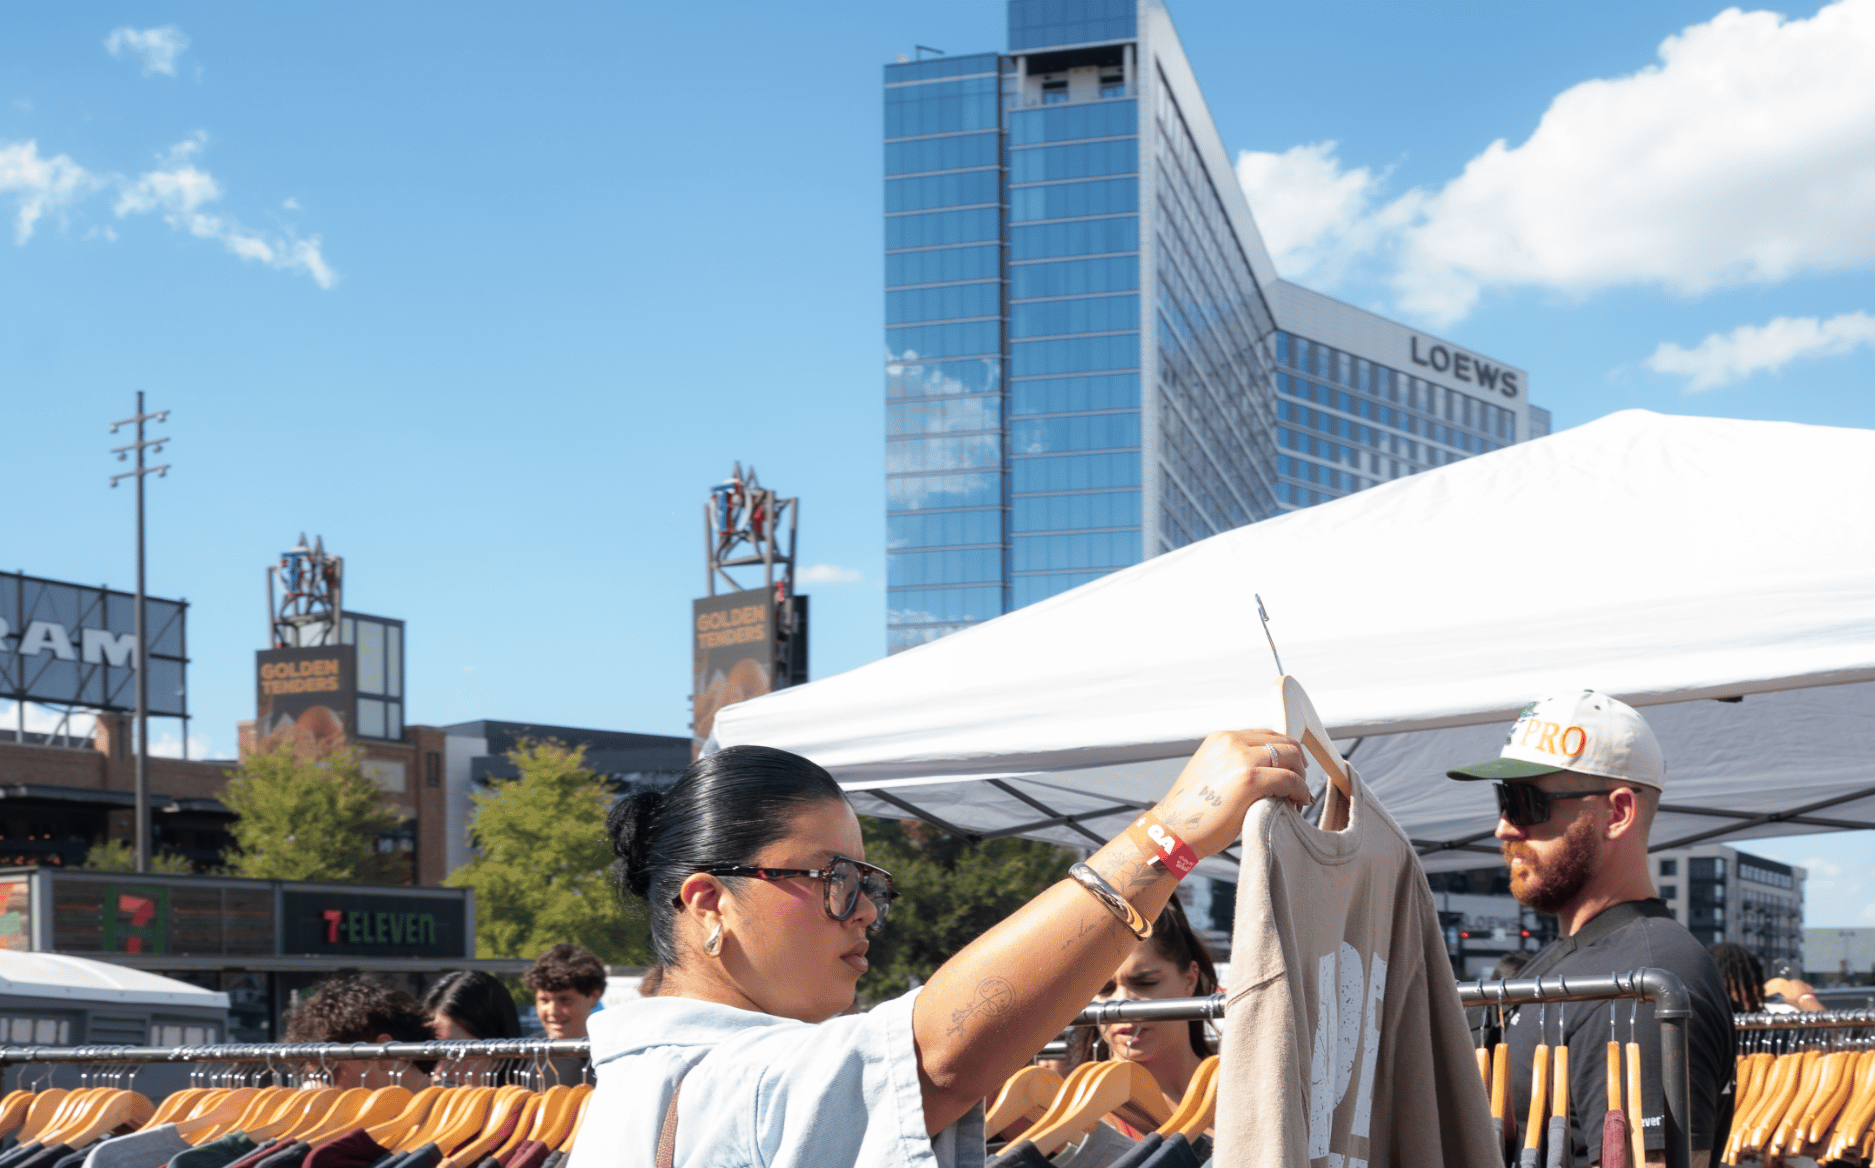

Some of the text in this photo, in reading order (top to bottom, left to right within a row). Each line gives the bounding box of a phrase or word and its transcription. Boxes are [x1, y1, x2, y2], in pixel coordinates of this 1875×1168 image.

[1410, 335, 1518, 398] LOEWS
[0, 616, 139, 671] AM
[261, 659, 339, 680] GOLDEN
[1519, 718, 1587, 758] PRO
